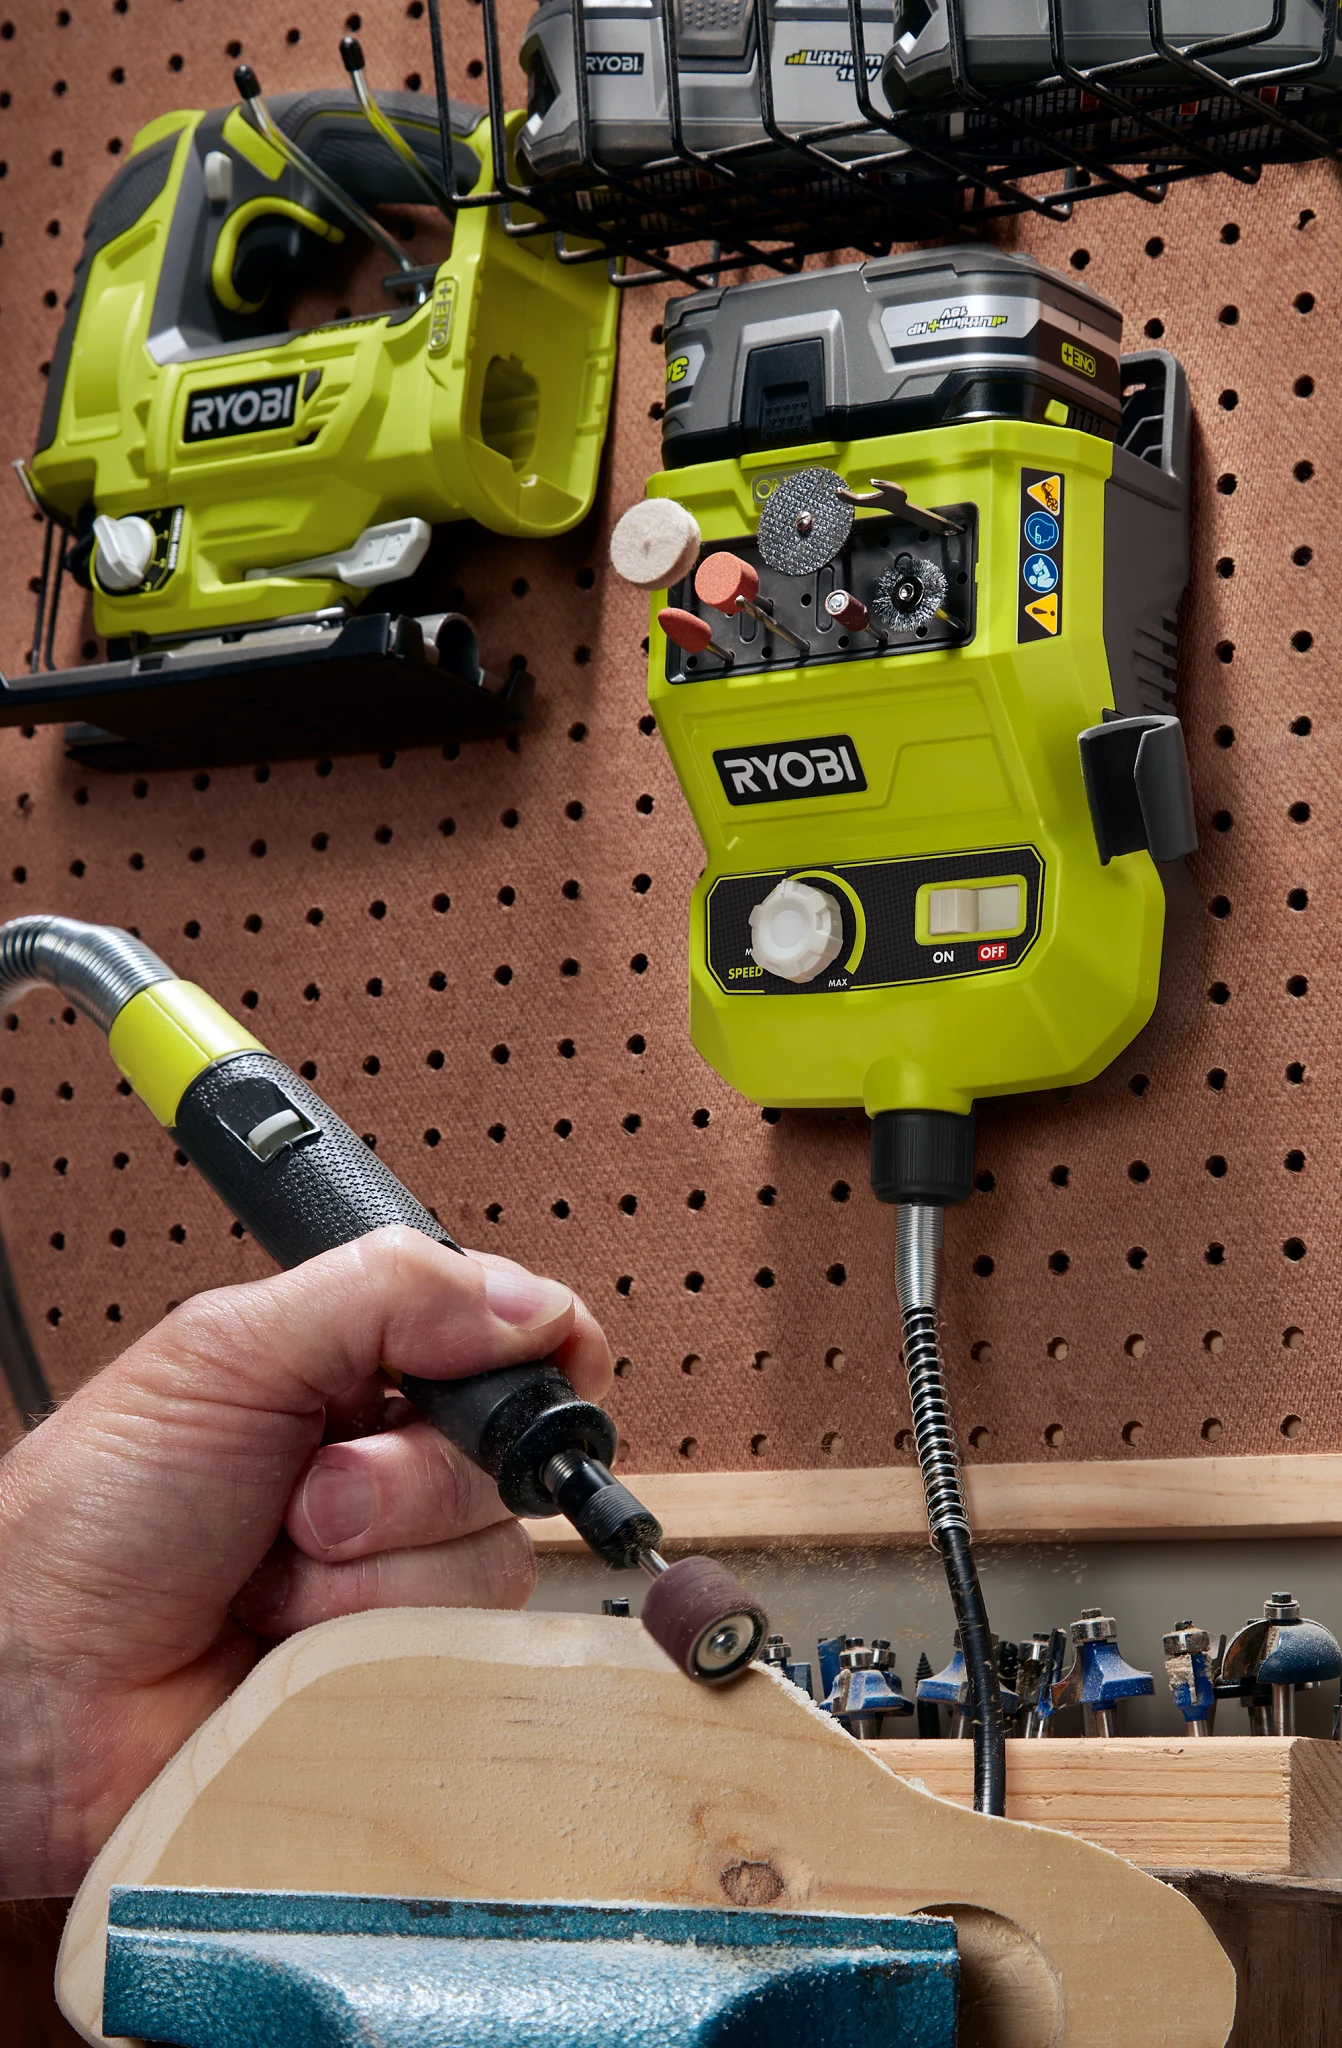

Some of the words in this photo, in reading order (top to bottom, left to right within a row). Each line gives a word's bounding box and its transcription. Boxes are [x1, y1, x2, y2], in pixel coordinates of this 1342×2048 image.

[586, 56, 639, 72] RYOBI
[804, 51, 882, 66] Lithim
[941, 306, 968, 319] 18V
[907, 322, 928, 336] HP
[191, 384, 294, 434] RYOBI
[723, 745, 857, 794] RYOBI
[932, 950, 954, 963] ON
[980, 945, 1005, 959] OFF
[728, 966, 763, 980] SPEED
[828, 978, 848, 988] MAX
